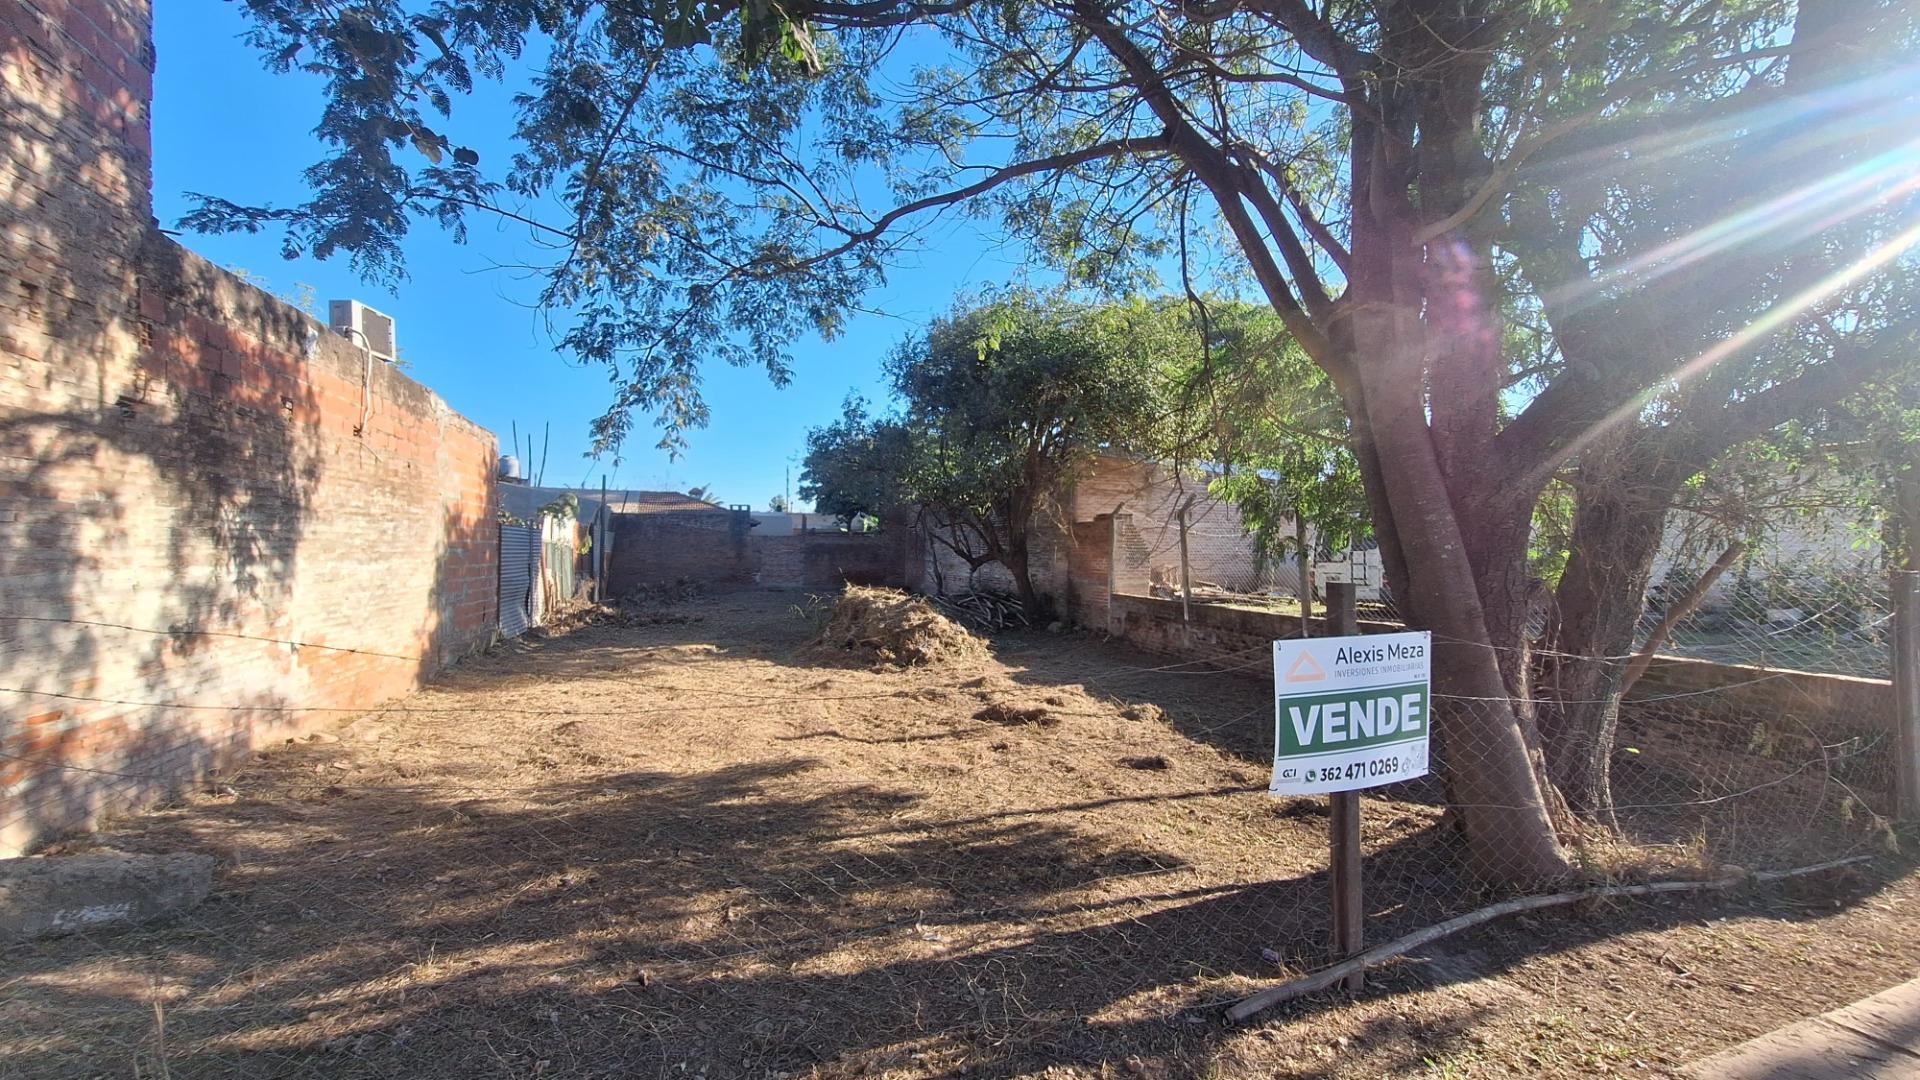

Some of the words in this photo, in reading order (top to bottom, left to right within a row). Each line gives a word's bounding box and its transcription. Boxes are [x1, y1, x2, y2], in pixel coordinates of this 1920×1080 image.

[1335, 645, 1383, 665] Alexis
[1388, 643, 1424, 660] Meza
[1334, 666, 1379, 678] INVERSIONES
[1289, 693, 1421, 746] VENDE
[1320, 766, 1342, 781] 362
[1345, 762, 1366, 780] 471
[1370, 756, 1399, 776] 0269
